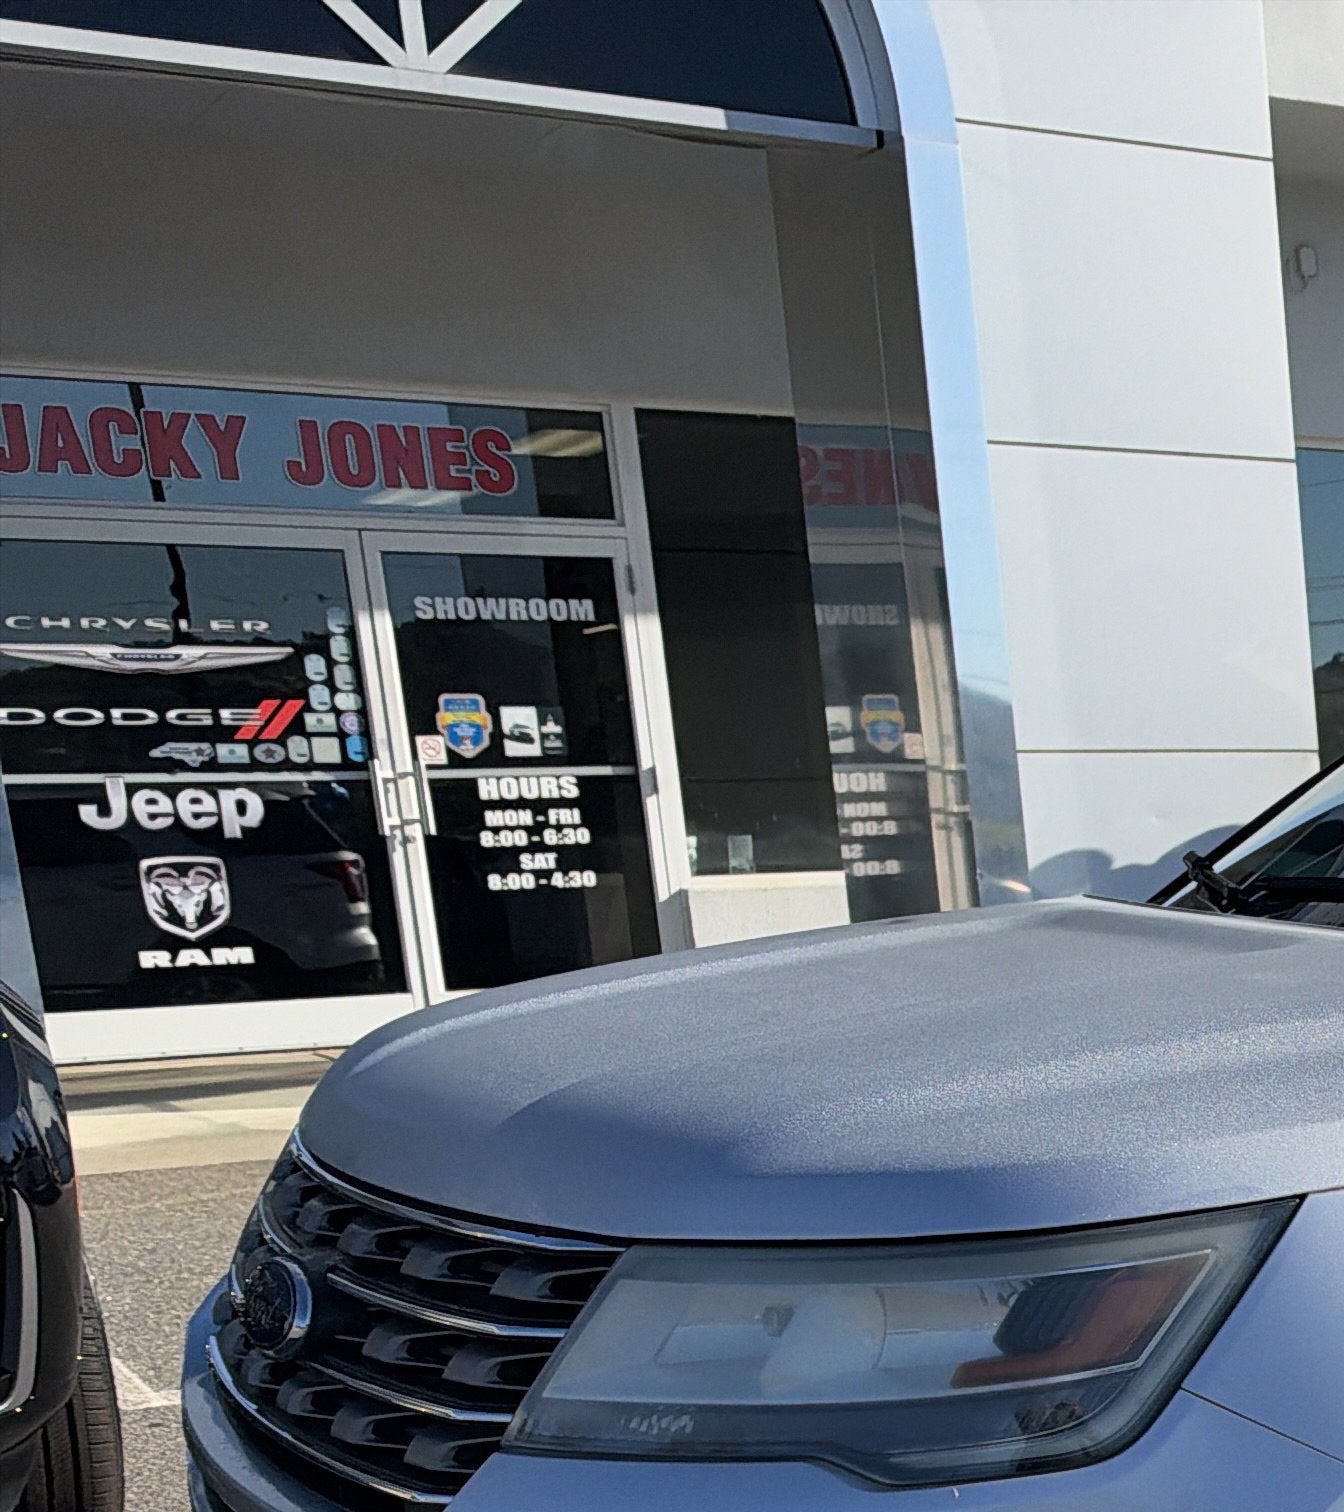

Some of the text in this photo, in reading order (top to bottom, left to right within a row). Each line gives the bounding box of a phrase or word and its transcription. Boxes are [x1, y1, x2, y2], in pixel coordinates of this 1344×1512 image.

[0, 403, 516, 495] JACKY JONES
[413, 596, 596, 621] SHOWROOM
[5, 616, 271, 634] CHRYSLER
[0, 707, 265, 726] DODGE
[477, 775, 580, 800] HOURS
[78, 776, 265, 838] Jeep
[484, 809, 534, 827] MON
[548, 808, 581, 825] FRI
[479, 829, 529, 848] 8:00
[543, 827, 591, 845] 6:30
[519, 852, 558, 870] SAT
[487, 872, 537, 890] 8:00
[551, 870, 597, 888] 4:30
[138, 946, 256, 969] RAM
